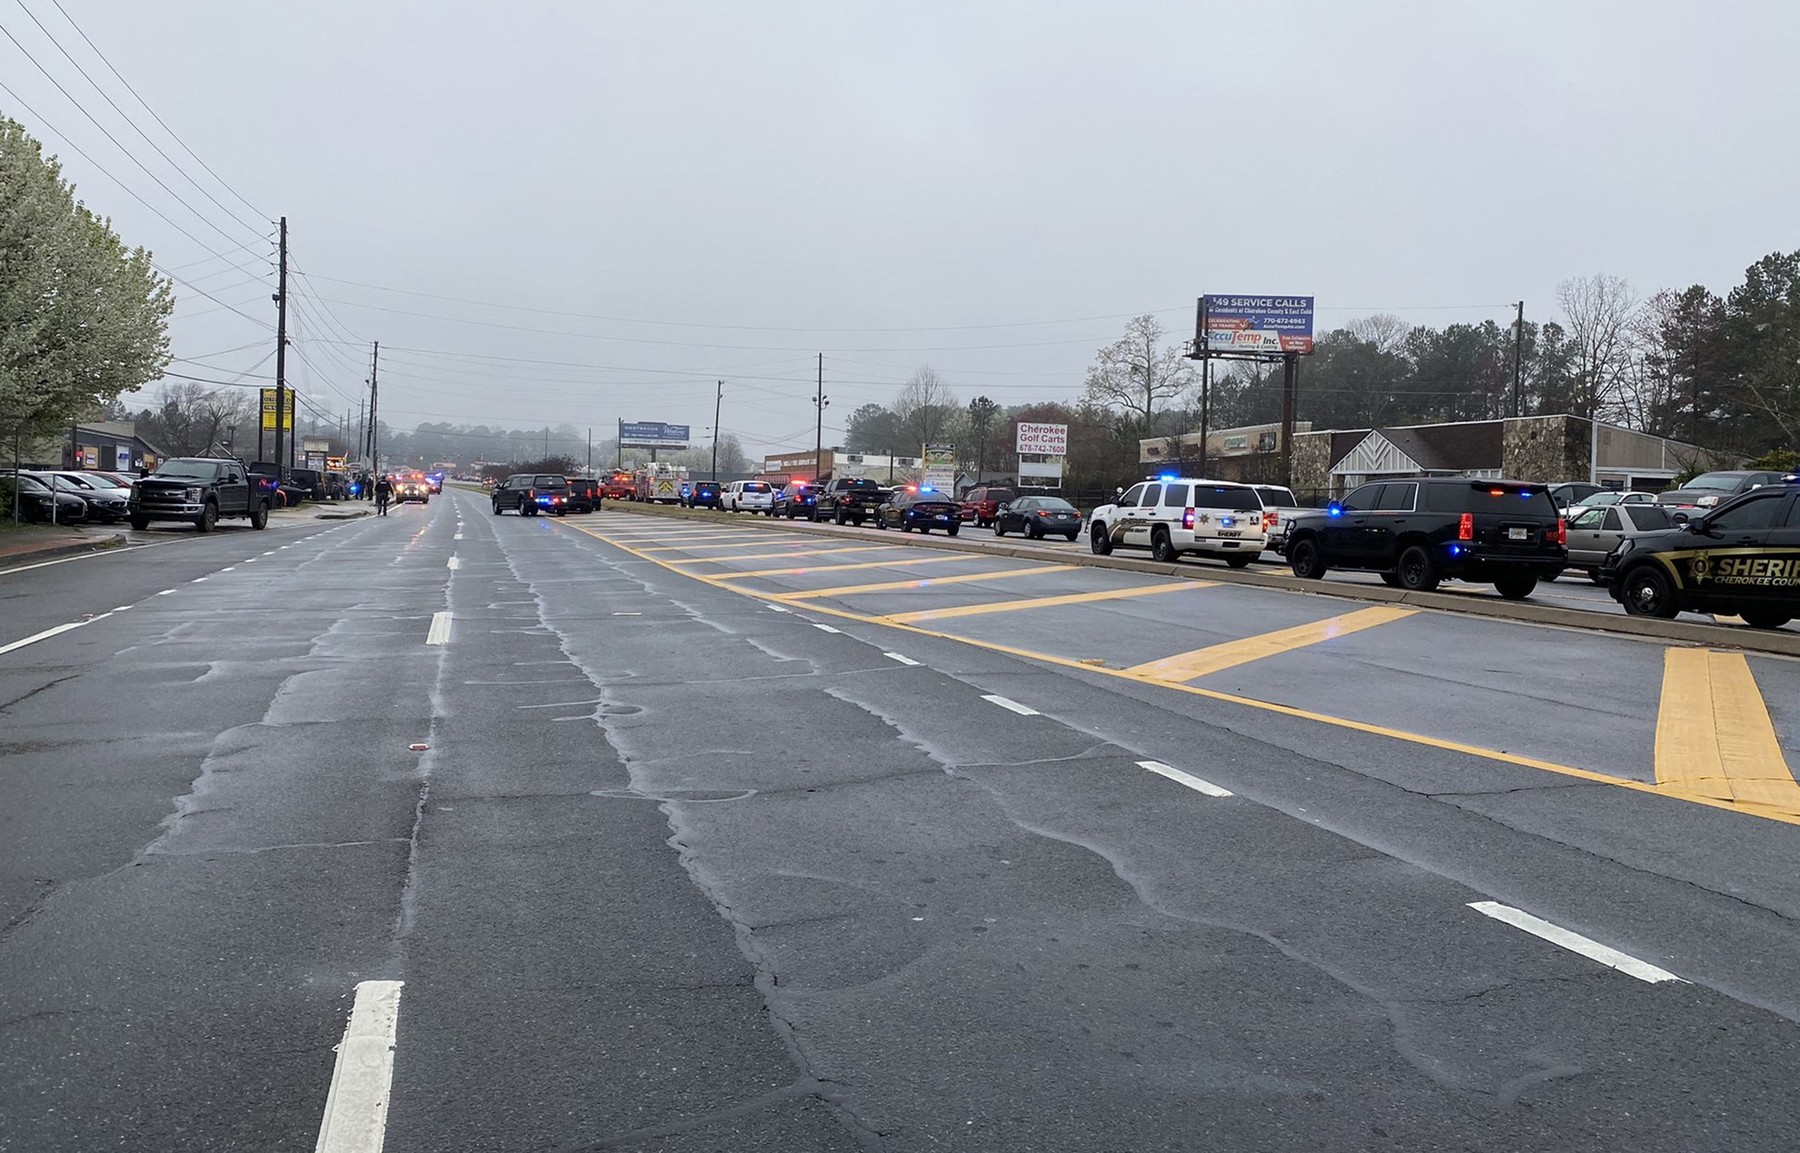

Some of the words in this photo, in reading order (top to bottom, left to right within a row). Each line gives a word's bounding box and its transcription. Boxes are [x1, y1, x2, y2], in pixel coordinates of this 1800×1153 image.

[1213, 297, 1229, 306] $49
[1231, 298, 1273, 307] SERVICE
[1275, 299, 1307, 307] CALLS
[1263, 337, 1279, 345] Inc.
[1020, 424, 1066, 435] Cherokee
[1020, 434, 1040, 442] Golf
[1041, 435, 1065, 443] Carts
[1019, 444, 1065, 453] 678-742-7600
[1714, 575, 1772, 586] CHEROKEE
